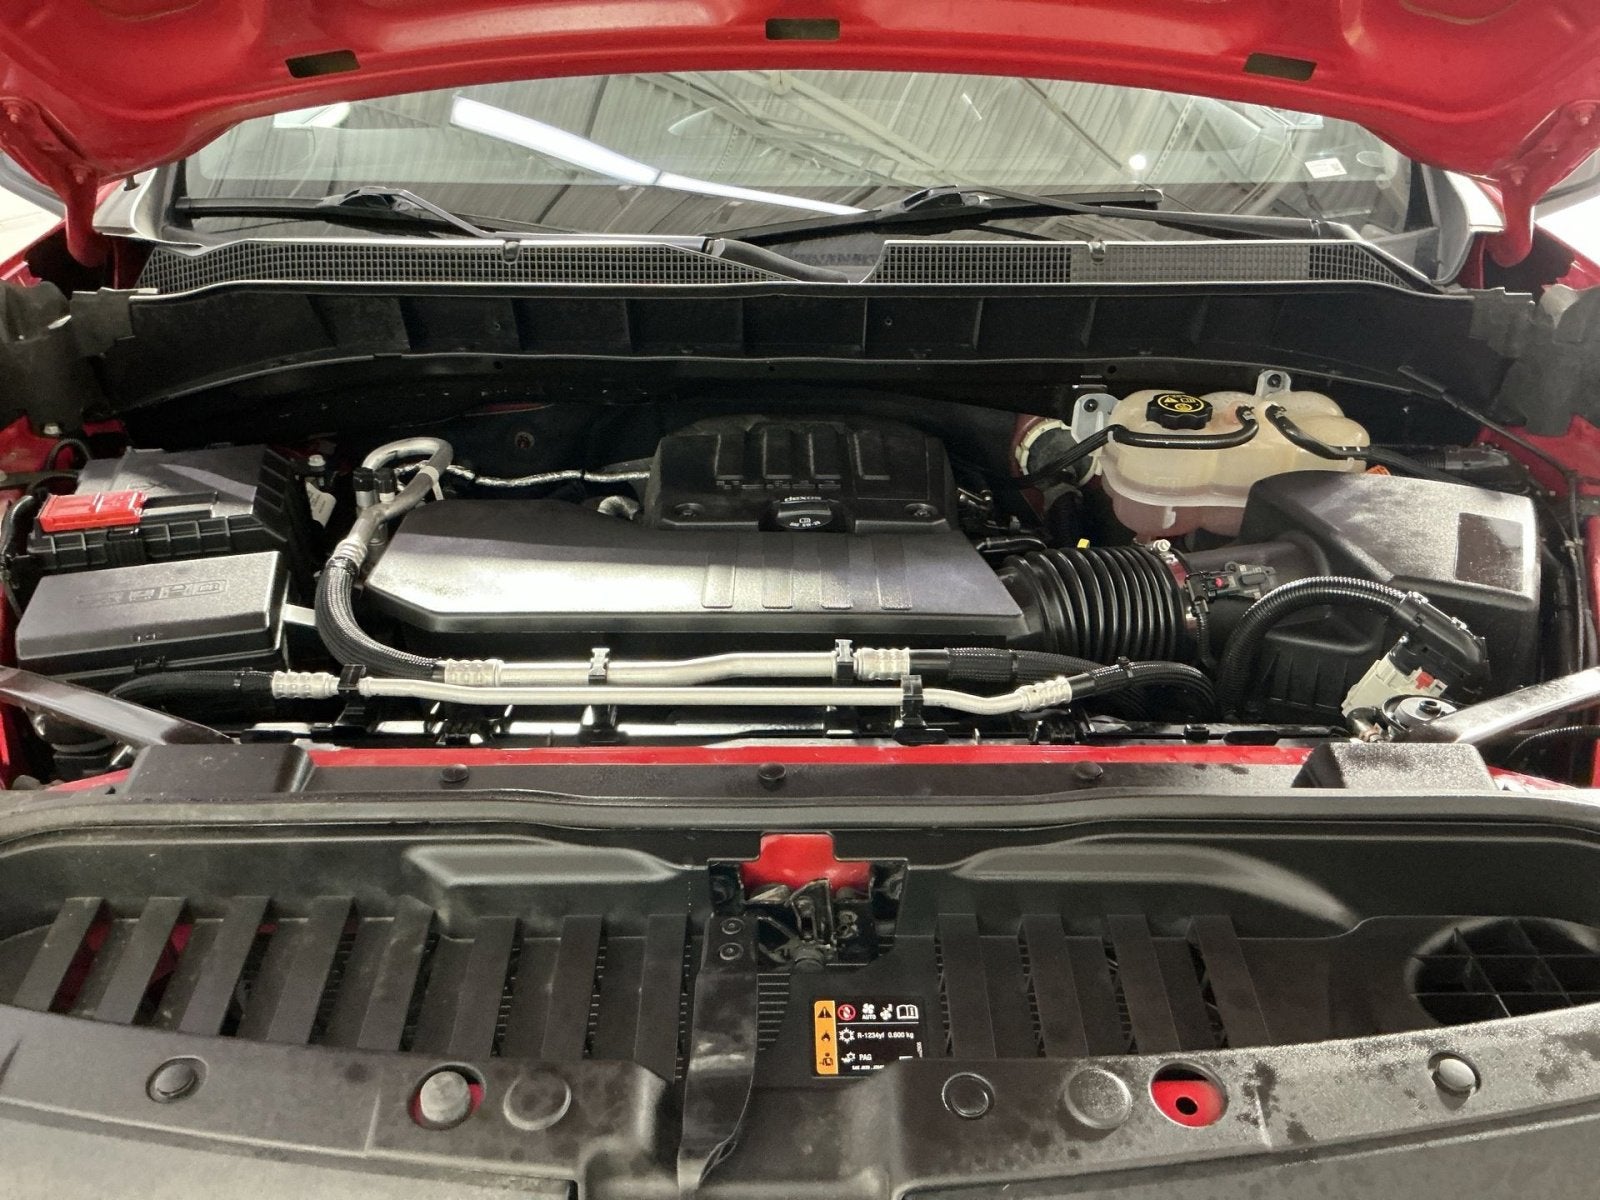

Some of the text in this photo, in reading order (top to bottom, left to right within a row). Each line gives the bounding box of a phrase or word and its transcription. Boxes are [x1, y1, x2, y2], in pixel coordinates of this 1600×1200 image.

[857, 1031, 885, 1040] R-1234yf
[905, 1031, 914, 1040] kg
[858, 1053, 873, 1061] PAG
